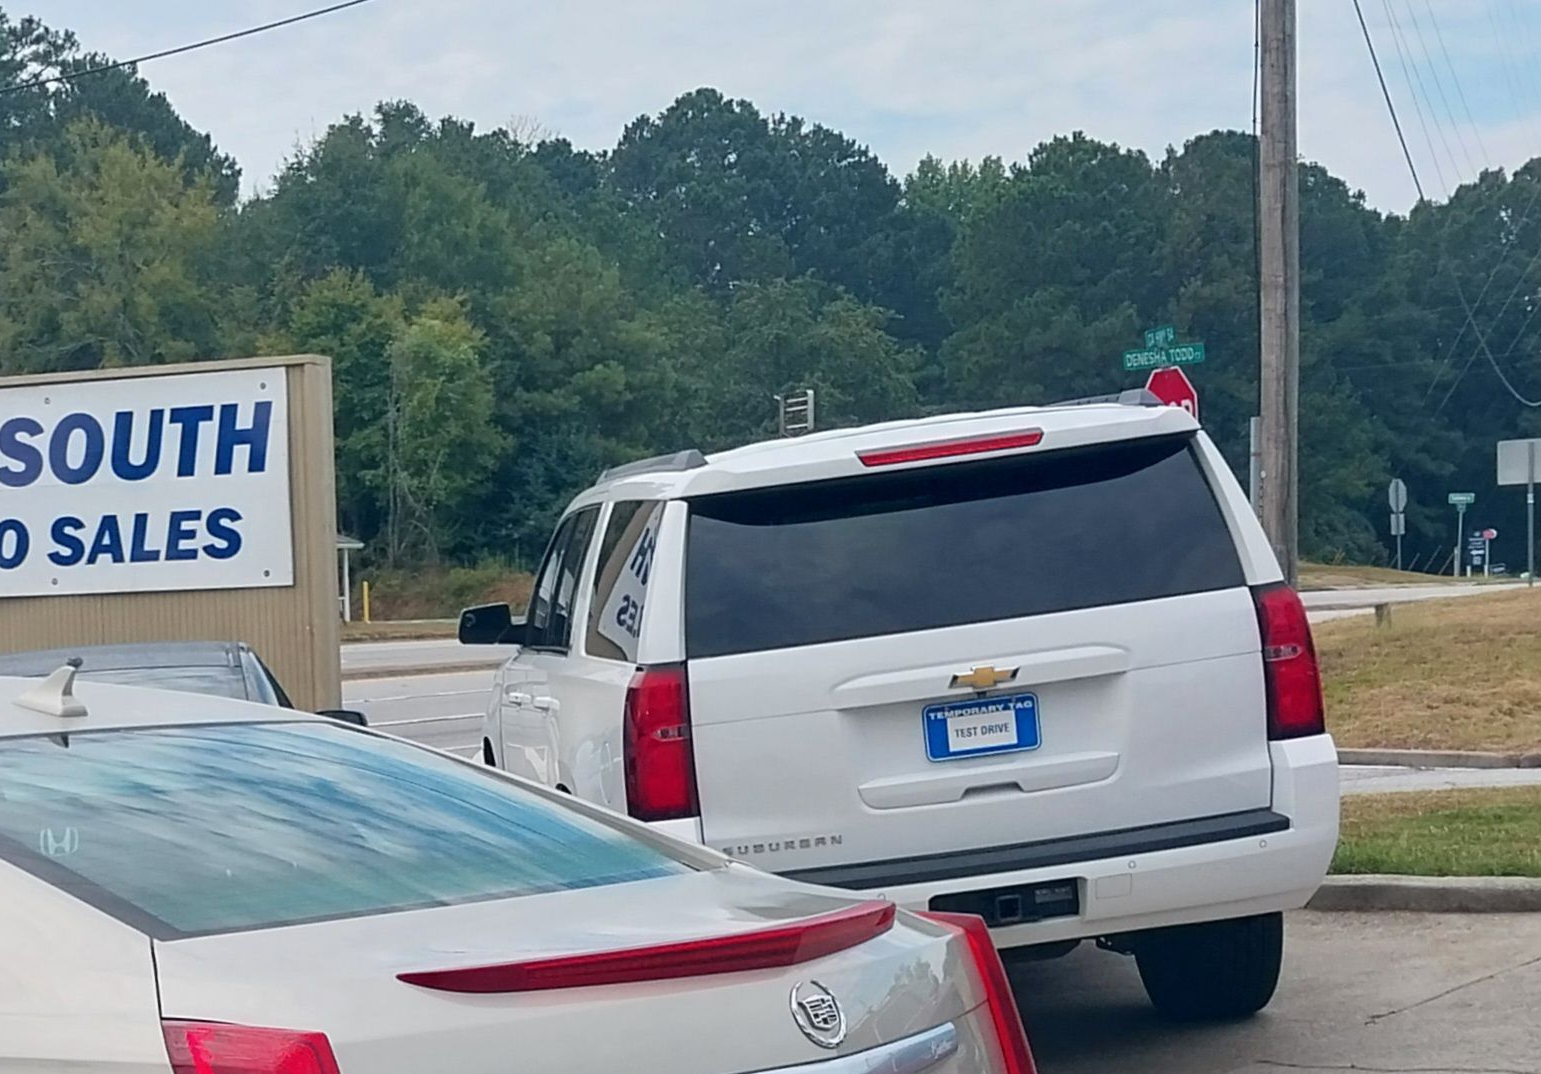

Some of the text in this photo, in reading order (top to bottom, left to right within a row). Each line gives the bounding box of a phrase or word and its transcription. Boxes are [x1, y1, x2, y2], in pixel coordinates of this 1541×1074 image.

[1169, 347, 1194, 362] TODD
[46, 507, 243, 567] SALES
[928, 700, 1034, 721] TEMPORARY TAG
[955, 722, 1010, 738] TEST DRIVE
[722, 834, 843, 857] SUBURBAN
